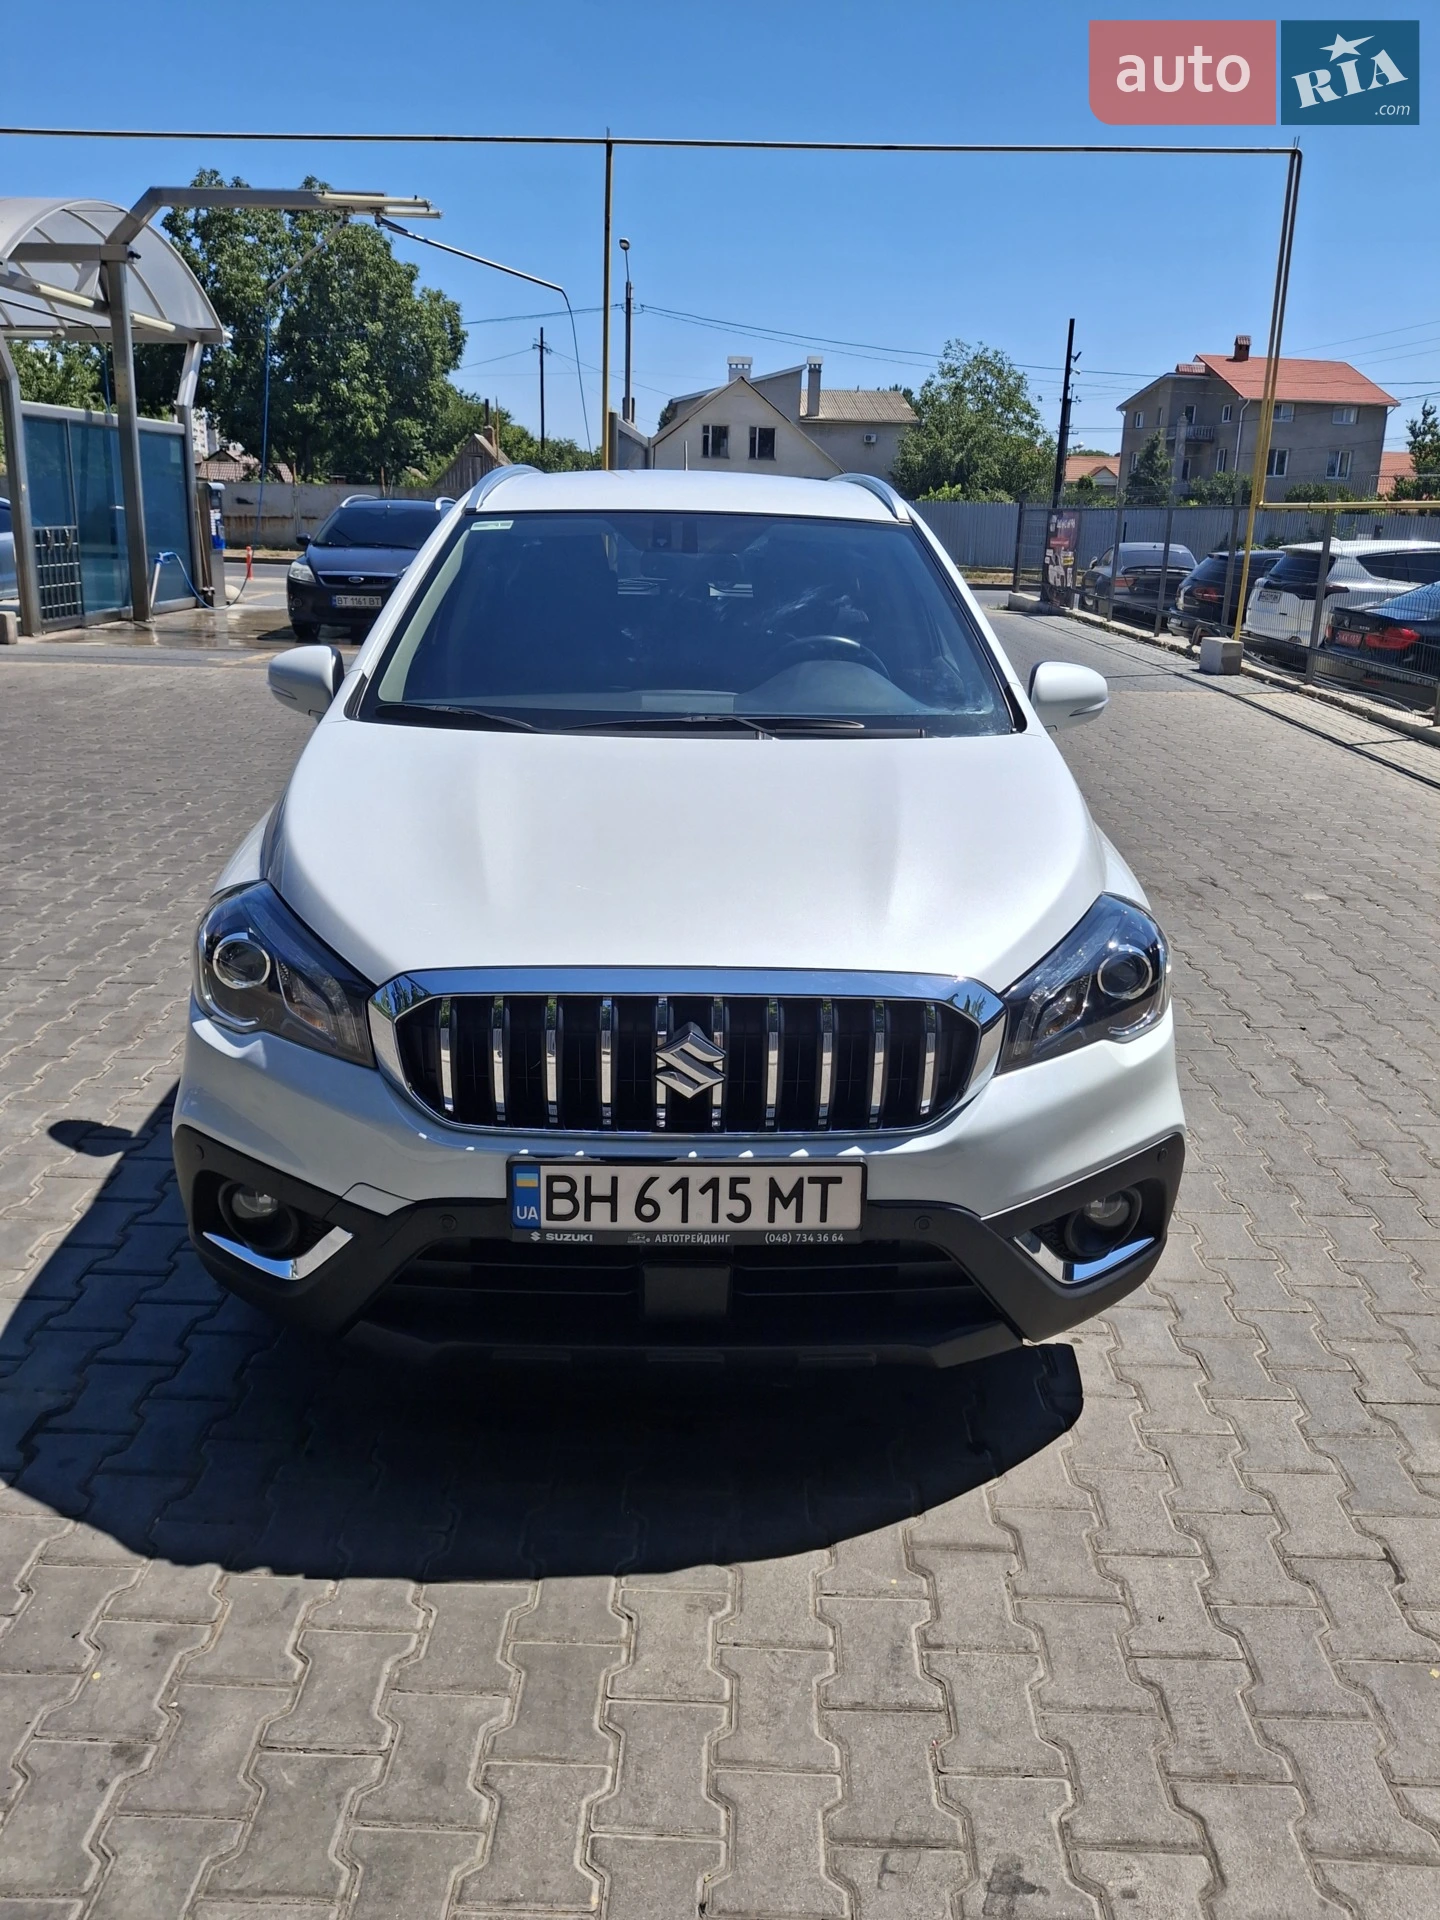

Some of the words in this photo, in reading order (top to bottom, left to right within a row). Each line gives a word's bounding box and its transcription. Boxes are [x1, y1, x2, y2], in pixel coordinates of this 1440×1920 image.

[546, 1175, 618, 1222] BH
[634, 1176, 751, 1224] 6115
[768, 1176, 843, 1224] MT
[516, 1206, 539, 1220] UA
[545, 1232, 593, 1242] SUZUKI
[654, 1233, 731, 1245] АВТОТРЕЙДИНГ
[764, 1233, 792, 1244] (048)
[796, 1233, 814, 1243] 734
[817, 1233, 829, 1243] 36
[831, 1233, 844, 1243] 64
